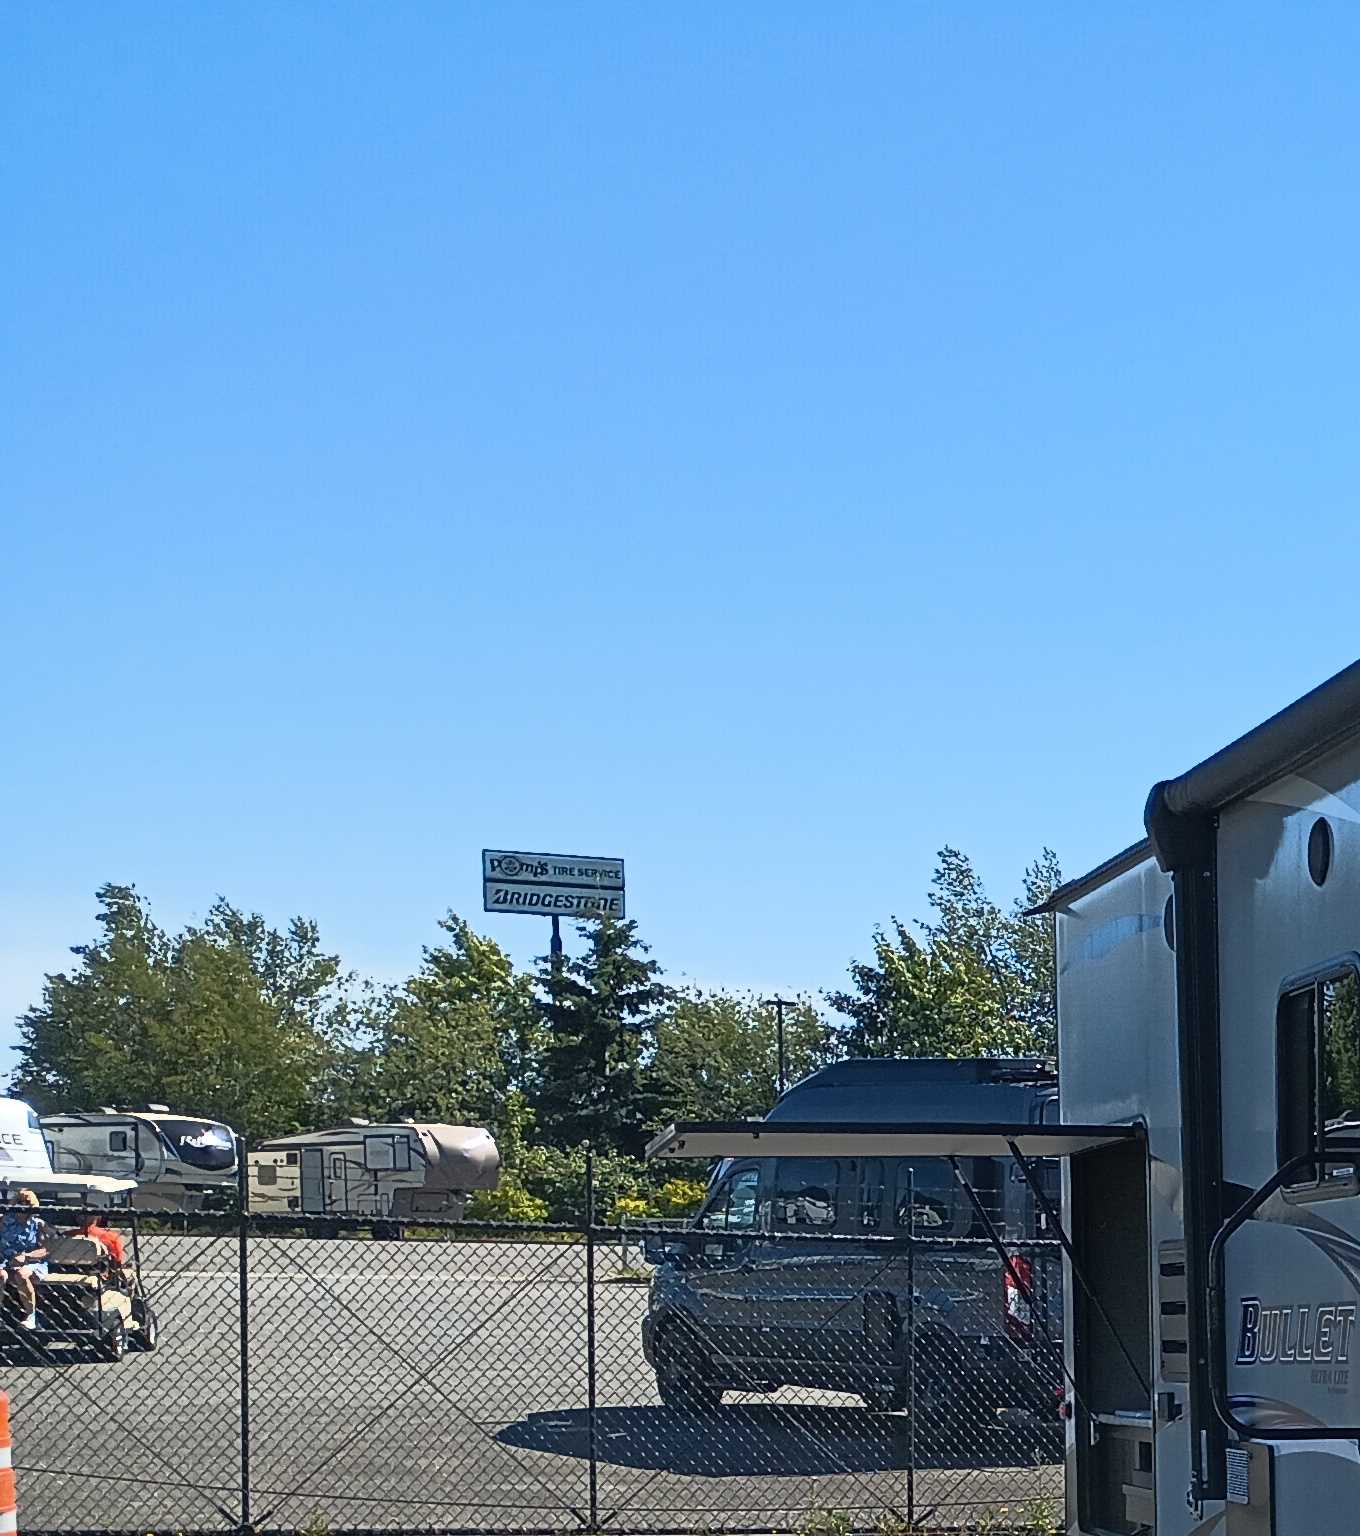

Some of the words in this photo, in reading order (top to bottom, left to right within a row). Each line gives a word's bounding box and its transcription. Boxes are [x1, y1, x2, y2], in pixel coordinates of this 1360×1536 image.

[553, 865, 576, 876] TIRE
[577, 867, 621, 880] SERVICE
[0, 1133, 23, 1146] CE
[1234, 1296, 1358, 1366] BULLET
